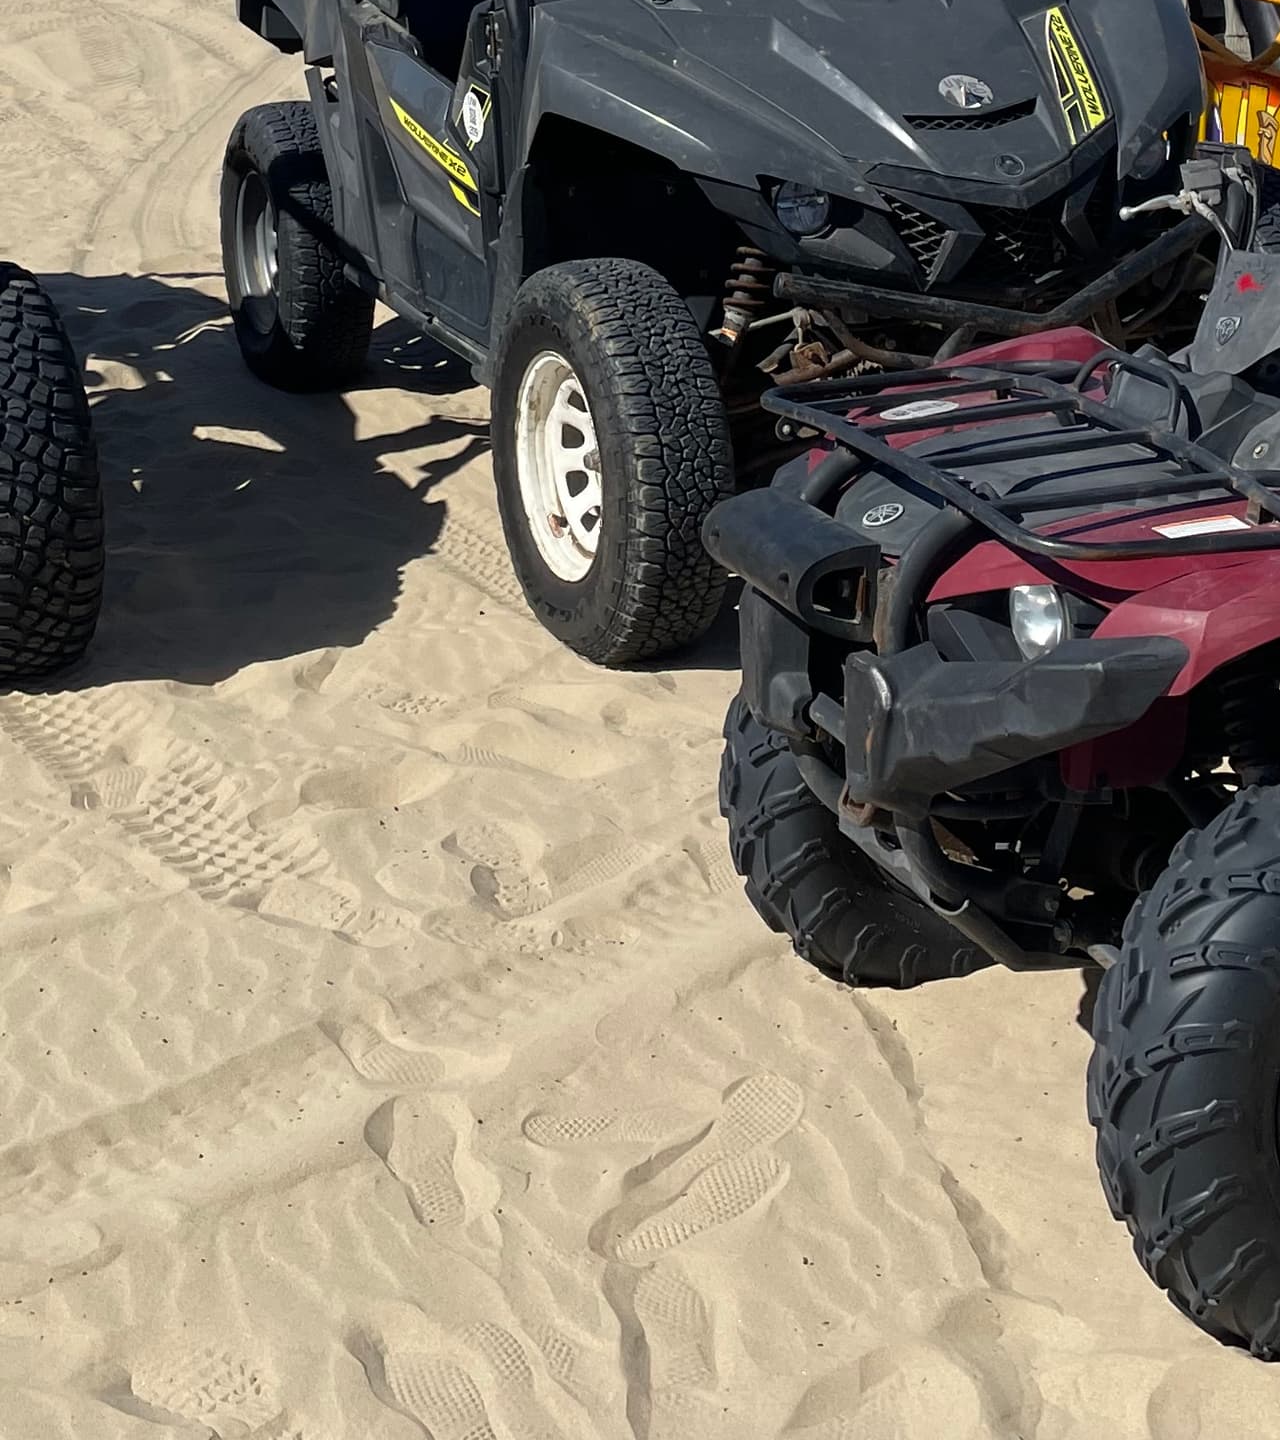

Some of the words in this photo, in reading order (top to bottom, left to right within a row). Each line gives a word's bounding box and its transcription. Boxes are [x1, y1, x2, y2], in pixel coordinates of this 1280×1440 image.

[1051, 14, 1068, 36] X2
[1060, 33, 1101, 116] WOLVERINE
[403, 115, 449, 164] WOLVERINE
[448, 160, 467, 177] X2
